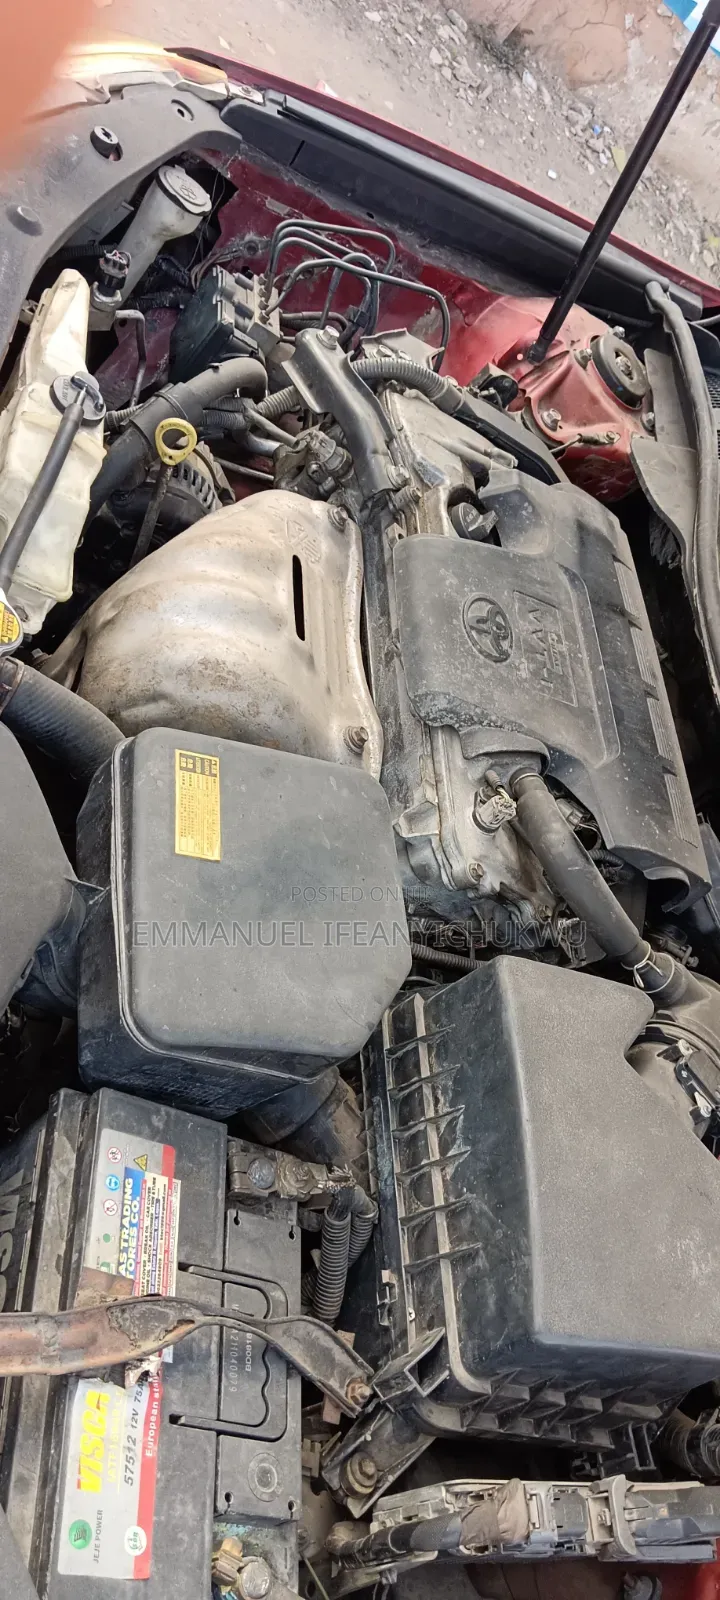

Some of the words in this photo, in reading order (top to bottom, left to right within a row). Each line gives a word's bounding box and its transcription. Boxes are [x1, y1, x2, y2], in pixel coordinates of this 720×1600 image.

[120, 1177, 134, 1250] TRADING
[131, 1196, 140, 1224] CO.
[131, 1408, 139, 1430] 12V
[145, 1401, 159, 1457] European
[78, 1389, 111, 1492] VISCA
[95, 1509, 103, 1541] POWER
[92, 1543, 101, 1565] JEJE
